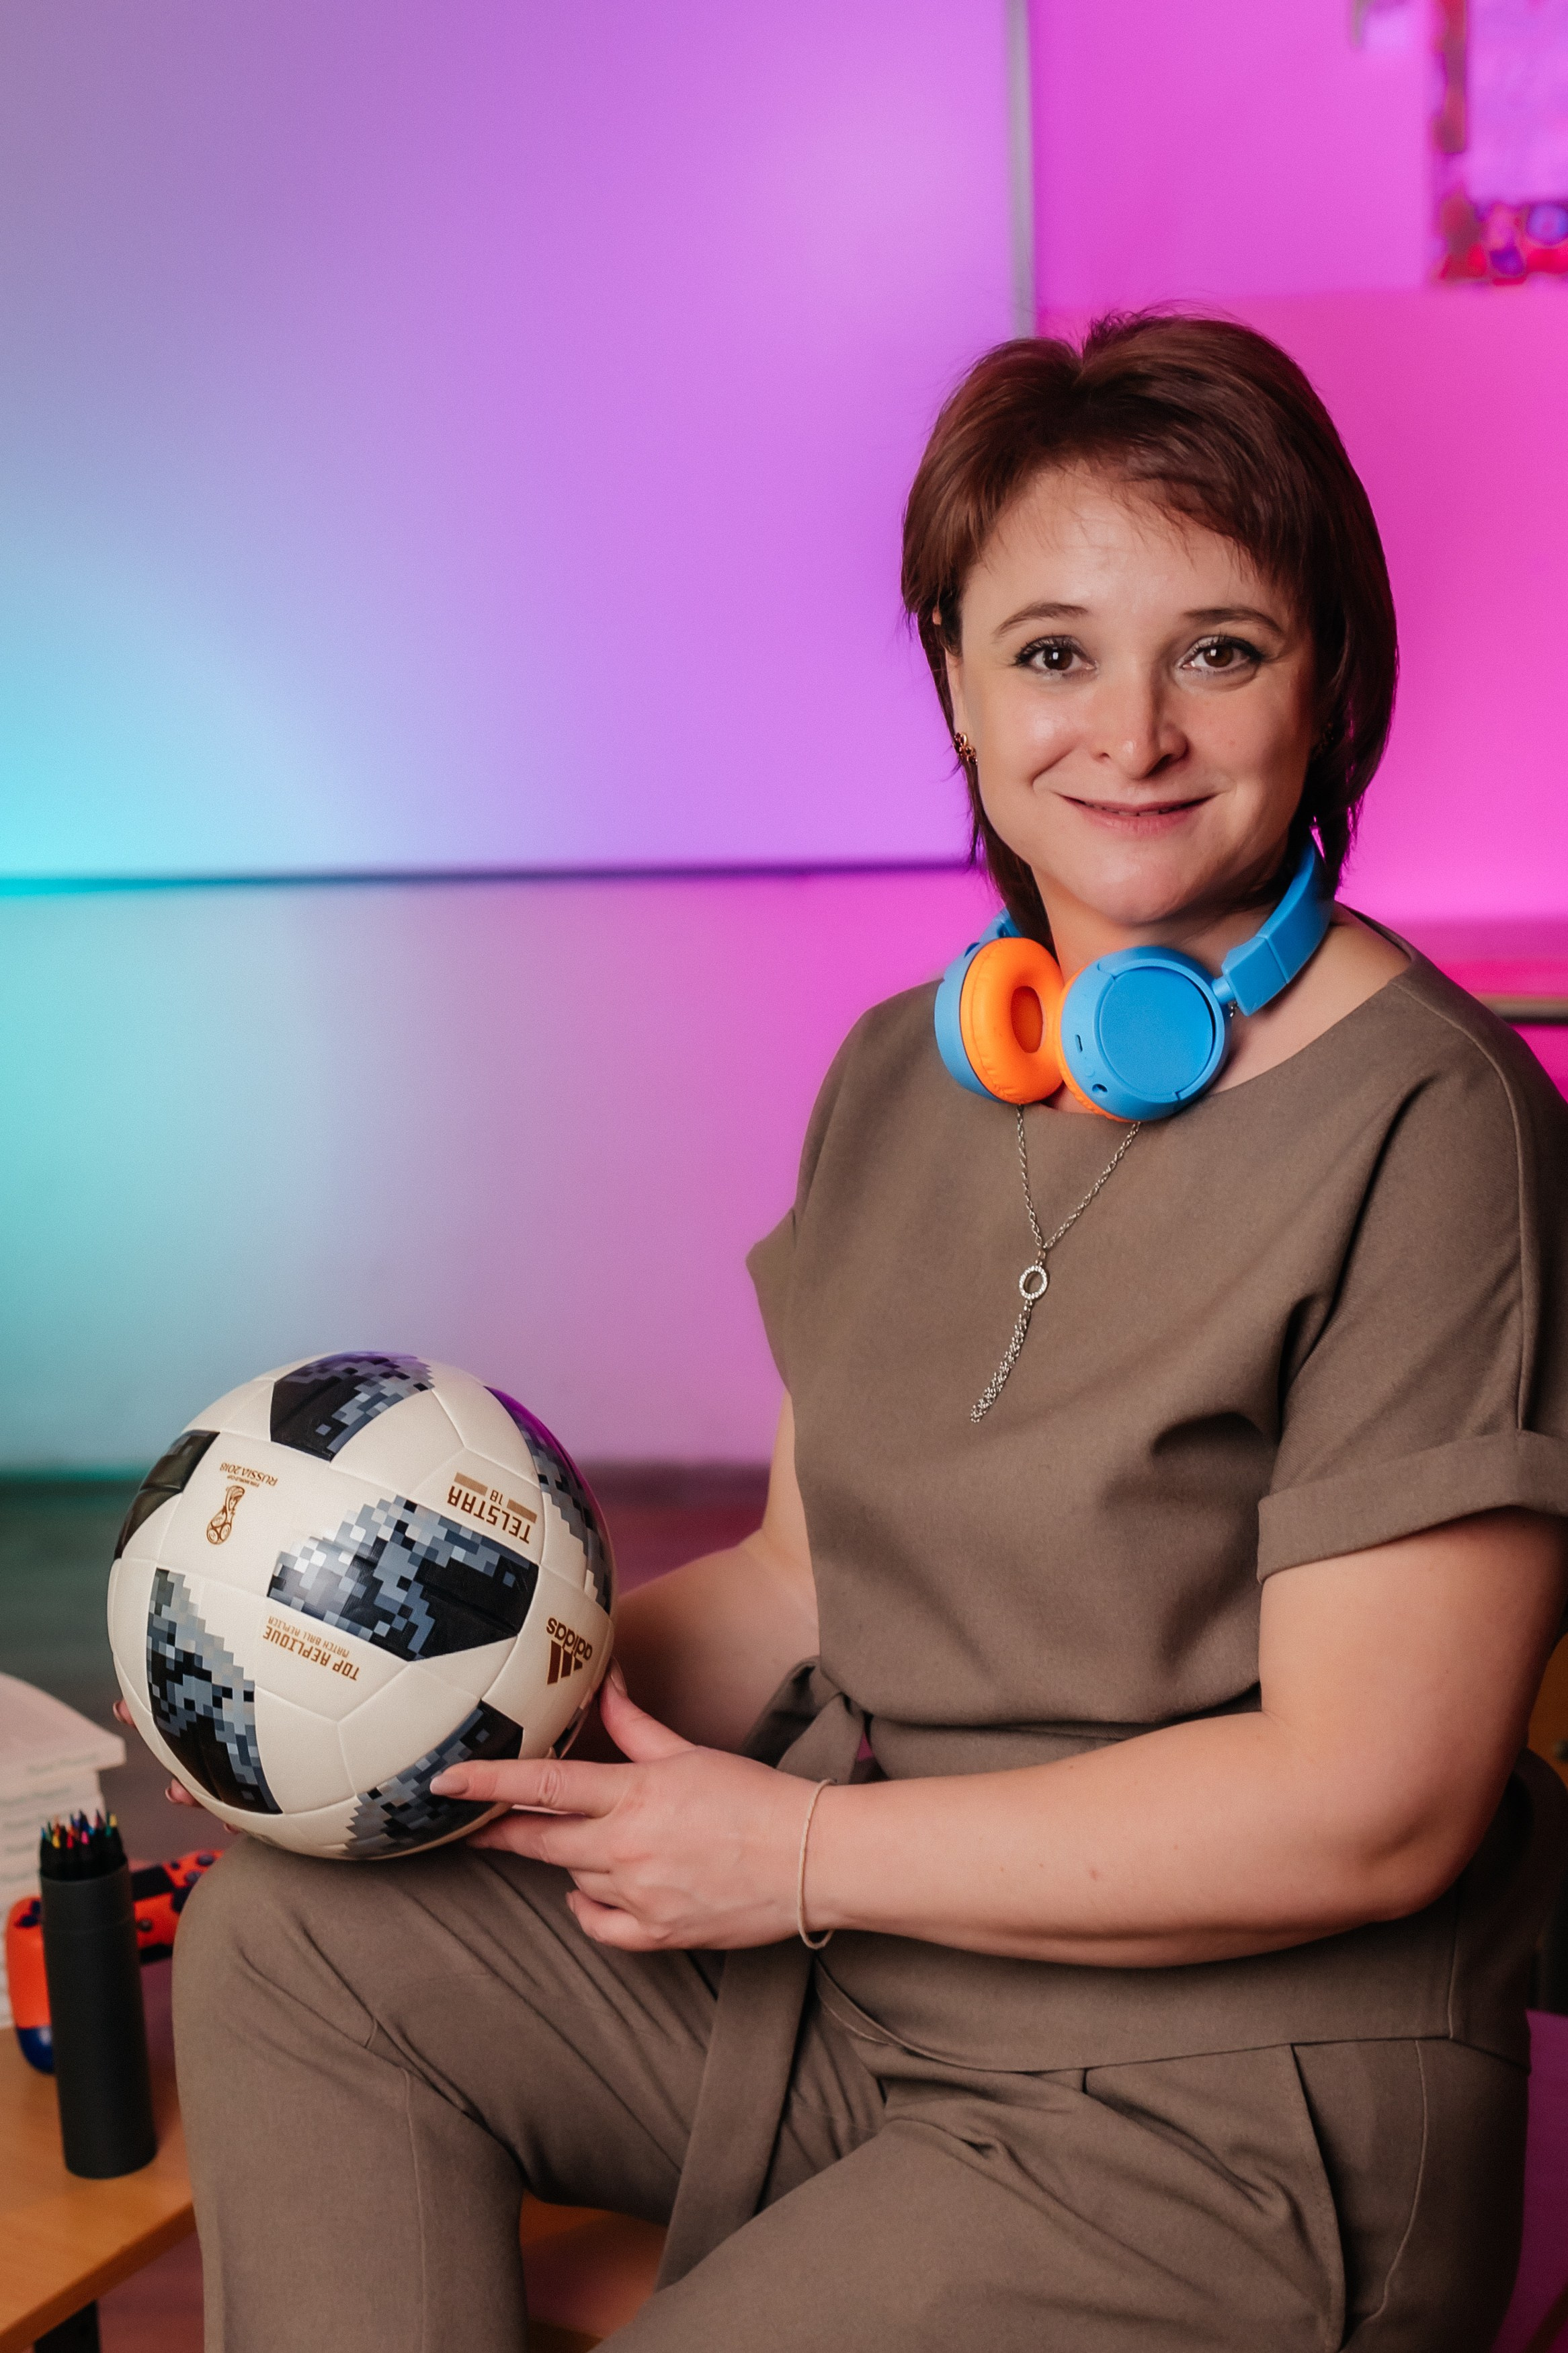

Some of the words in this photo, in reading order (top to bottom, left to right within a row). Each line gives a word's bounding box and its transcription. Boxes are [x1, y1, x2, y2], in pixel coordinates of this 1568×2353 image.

[220, 1462, 242, 1474] 2018
[242, 1468, 278, 1486] RUSSIA
[489, 1489, 503, 1506] 18
[447, 1485, 531, 1544] TELSTAR
[267, 1616, 301, 1637] REPLICA
[262, 1625, 331, 1667] REPLIQUE
[303, 1634, 322, 1646] BALL
[546, 1617, 593, 1661] adidas
[323, 1640, 350, 1659] MATCH
[332, 1660, 360, 1681] TOP
